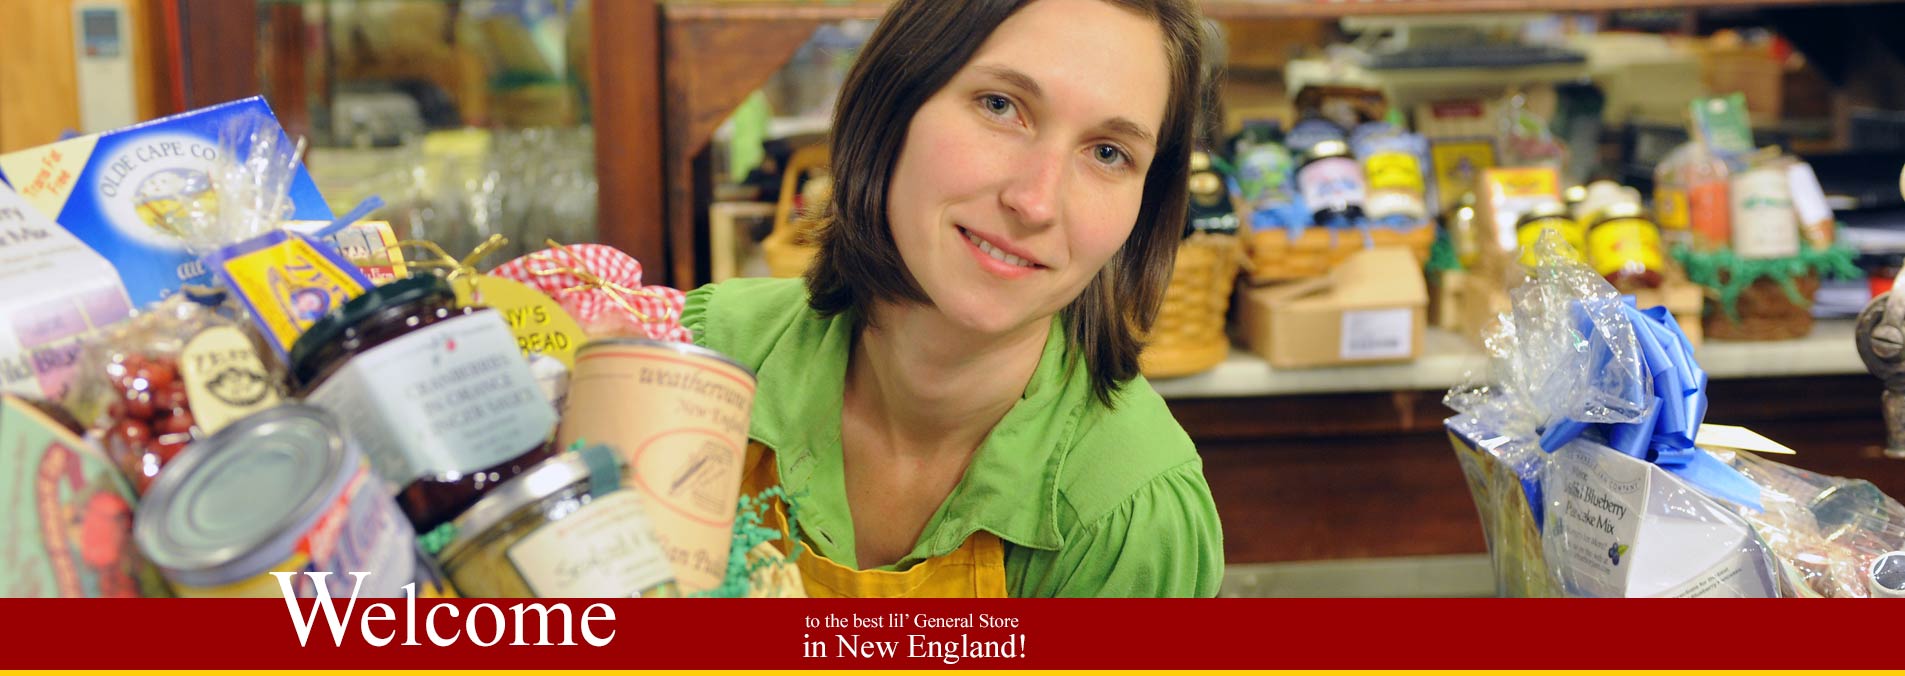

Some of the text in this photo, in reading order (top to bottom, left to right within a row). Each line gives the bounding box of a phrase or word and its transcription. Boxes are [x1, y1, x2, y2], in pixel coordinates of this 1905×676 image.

[101, 142, 217, 198] OLDE CAPE CO
[1584, 485, 1627, 520] Blueberry
[1596, 515, 1615, 535] Mix
